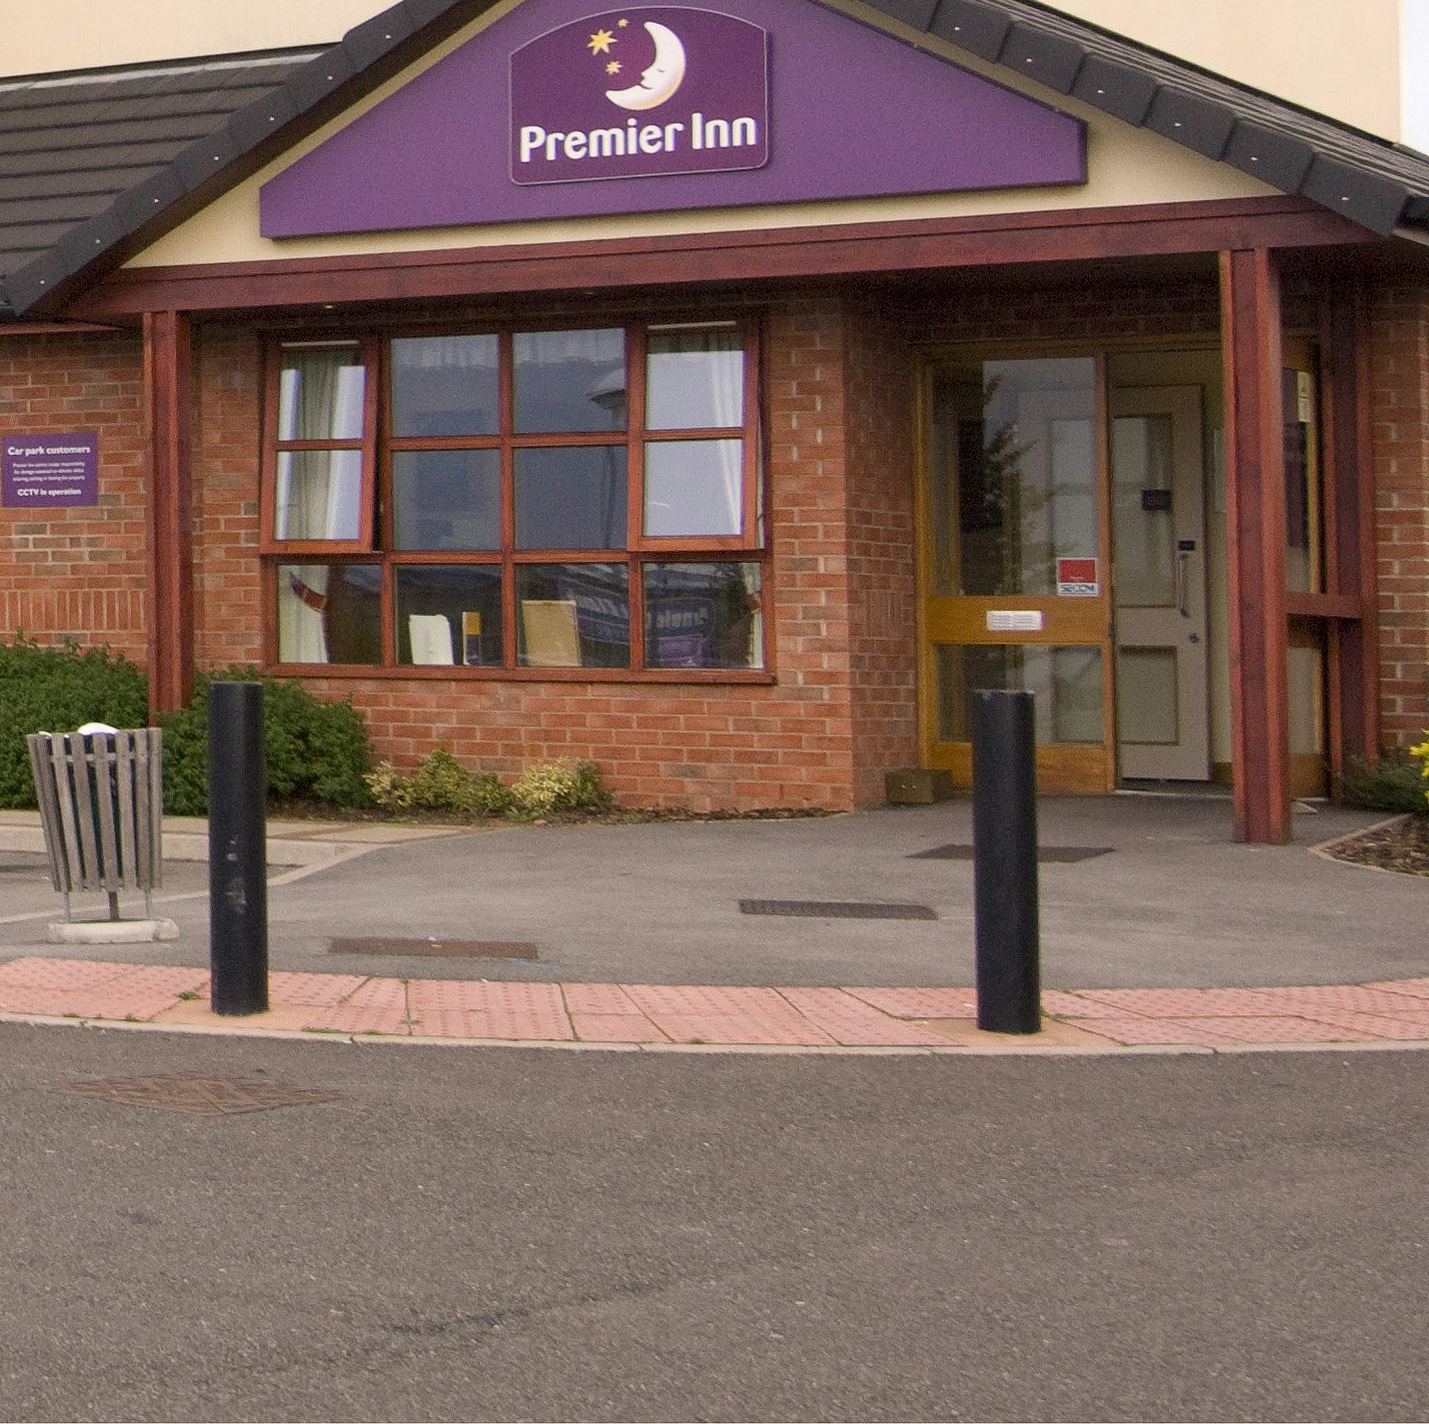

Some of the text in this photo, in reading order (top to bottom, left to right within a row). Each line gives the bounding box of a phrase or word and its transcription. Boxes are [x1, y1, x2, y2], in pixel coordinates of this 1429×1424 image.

[519, 112, 757, 163] Premier Inn
[7, 445, 91, 457] Car park customers
[17, 487, 82, 497] CCTV in operation
